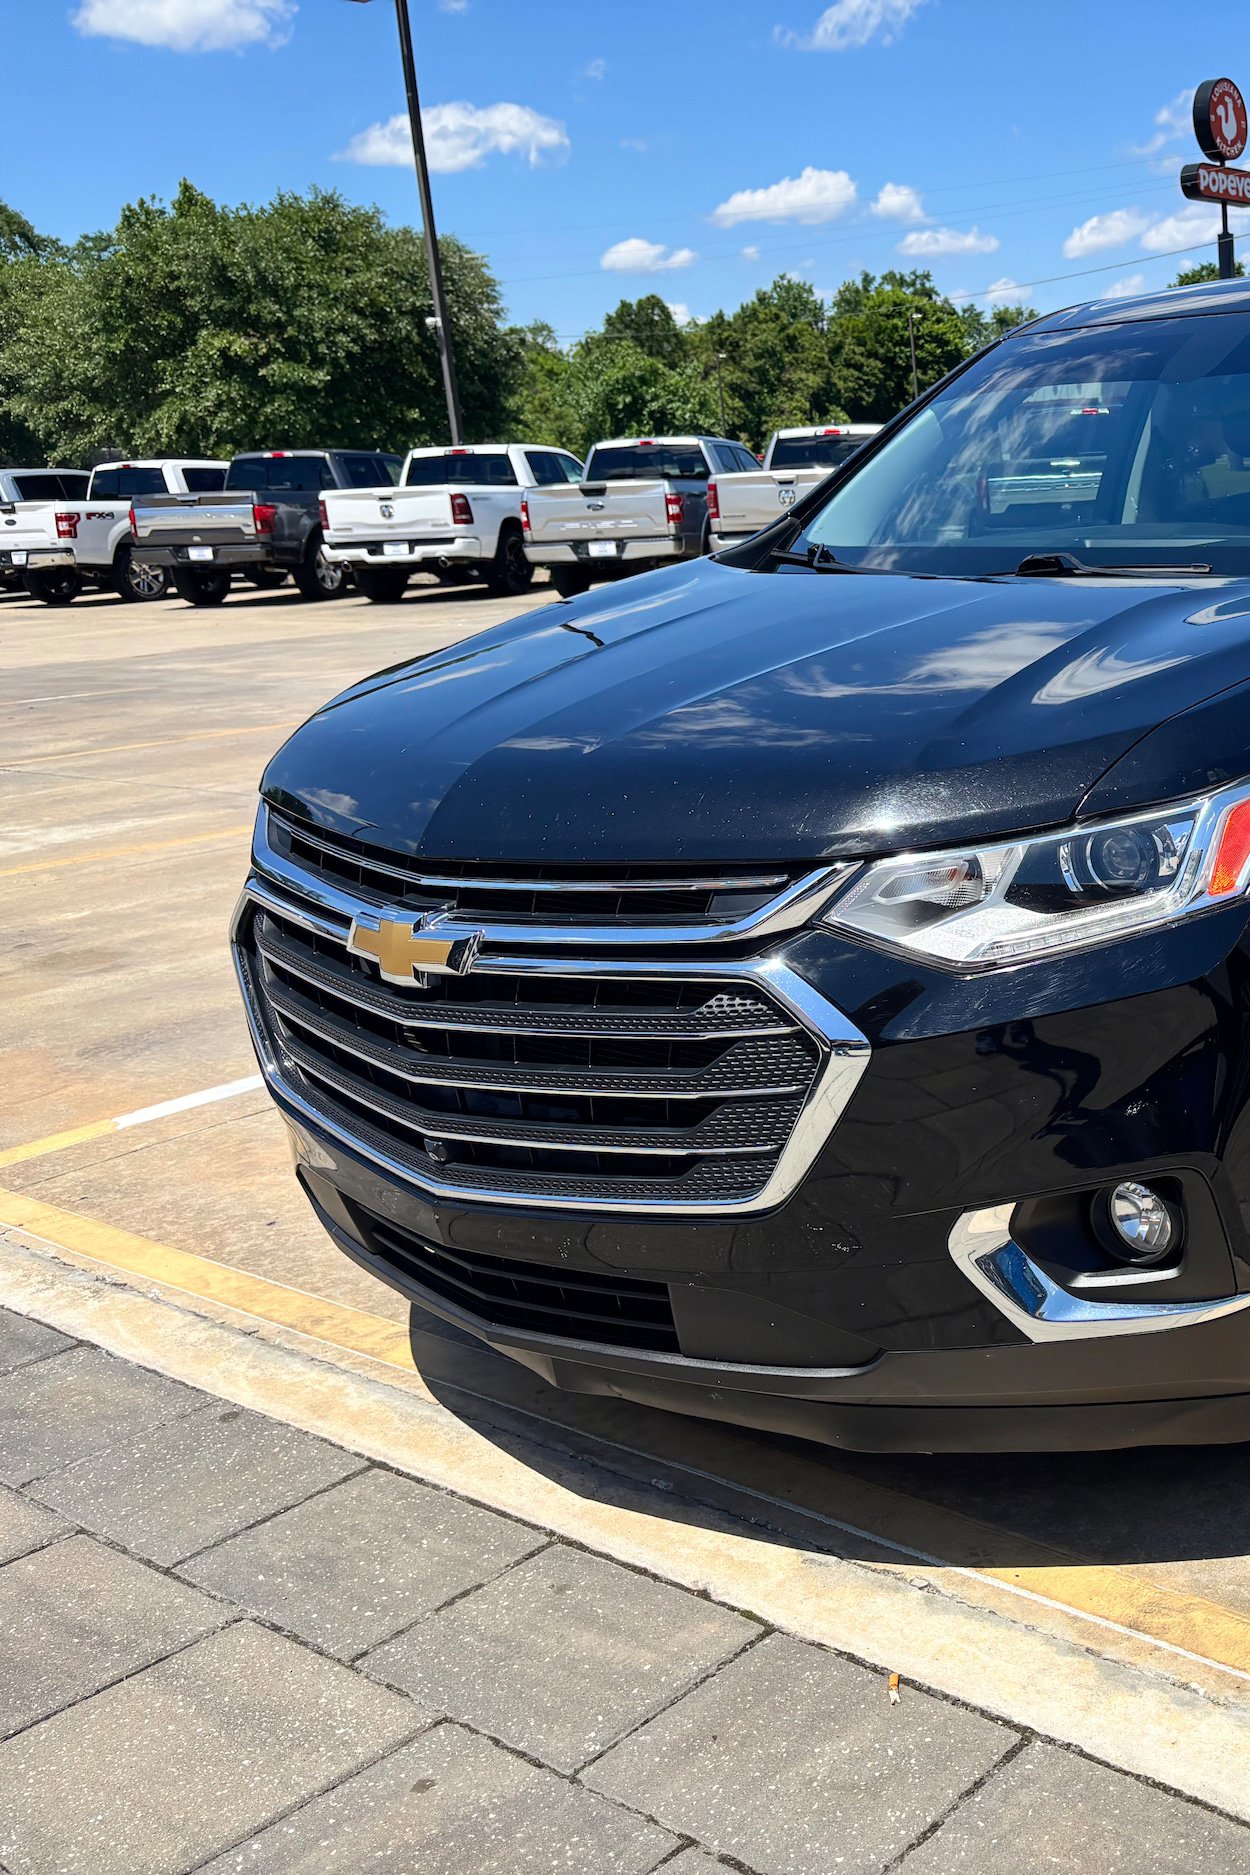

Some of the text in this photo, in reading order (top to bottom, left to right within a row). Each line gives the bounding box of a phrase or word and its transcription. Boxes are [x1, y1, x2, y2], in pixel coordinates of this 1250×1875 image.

[1211, 82, 1242, 107] LOUISIANA
[1216, 136, 1243, 156] KITCHEN
[86, 512, 115, 520] FX4
